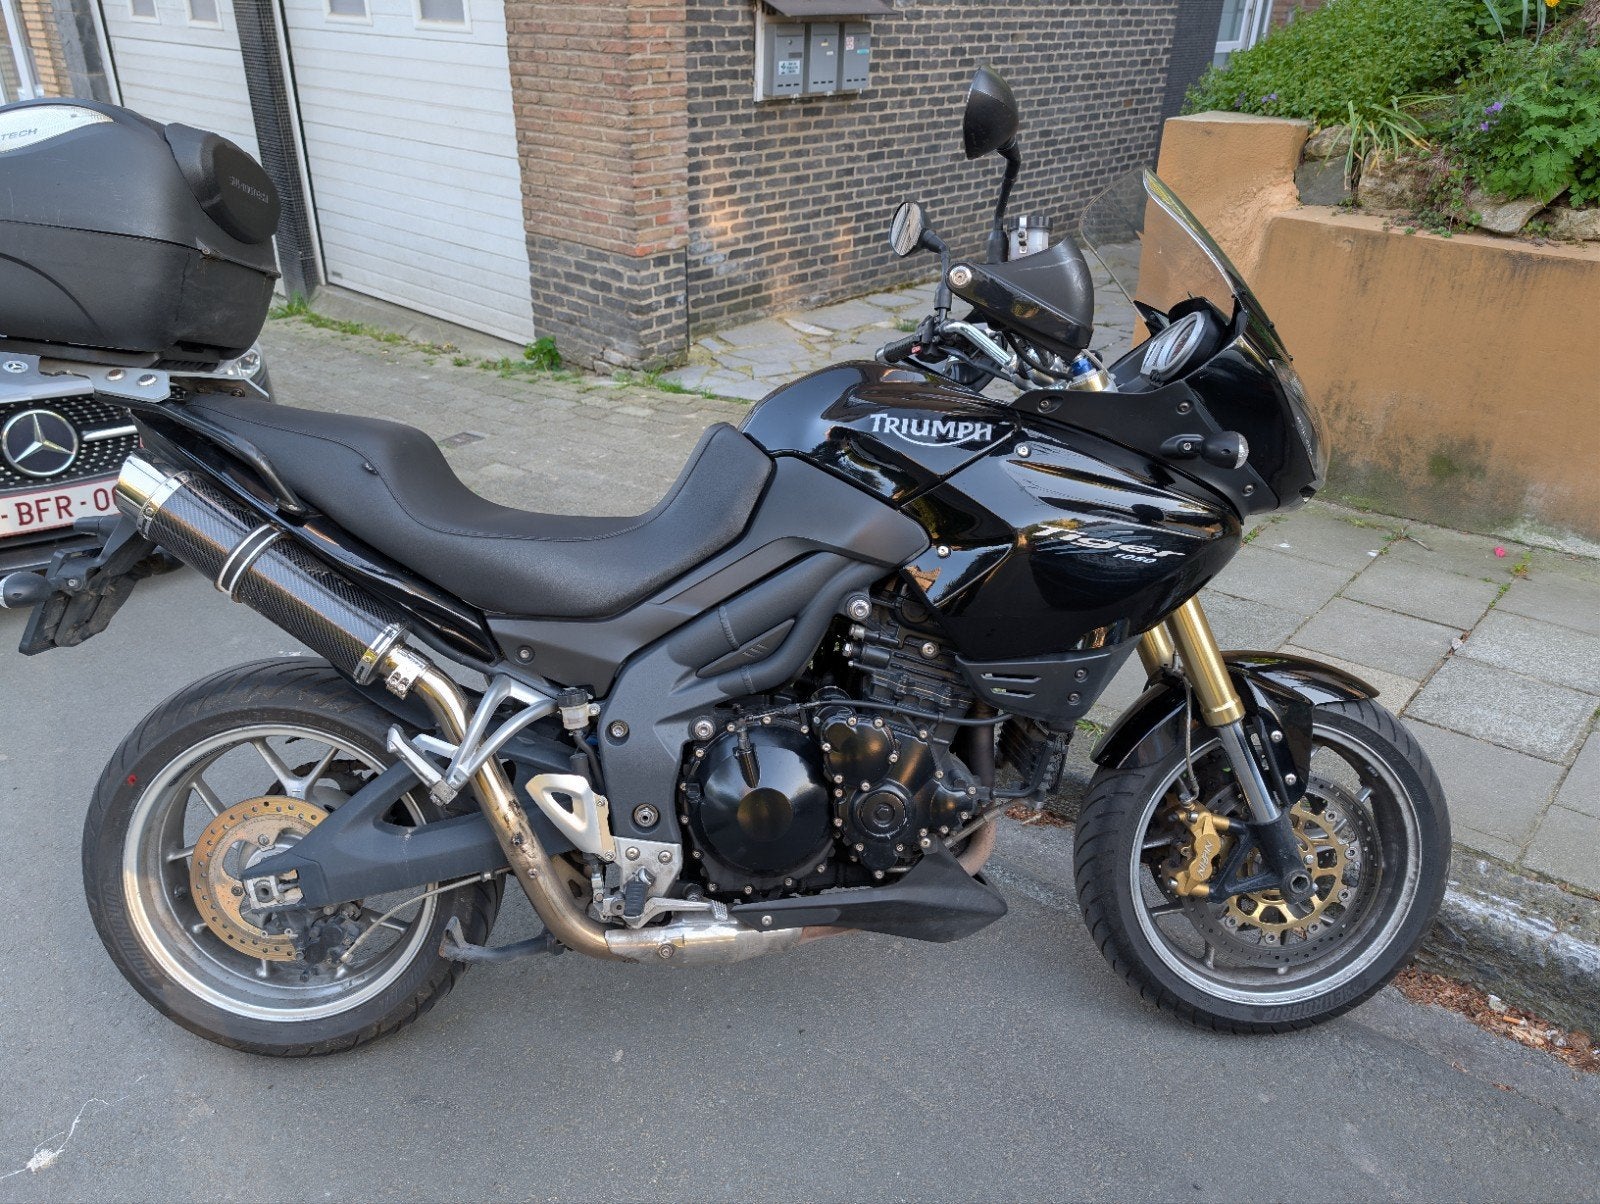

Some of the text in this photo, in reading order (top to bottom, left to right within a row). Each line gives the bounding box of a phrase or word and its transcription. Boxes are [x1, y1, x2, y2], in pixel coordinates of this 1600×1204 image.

[870, 413, 992, 446] TRIUMPH
[1032, 524, 1186, 557] Tiger
[1113, 553, 1157, 564] 1050
